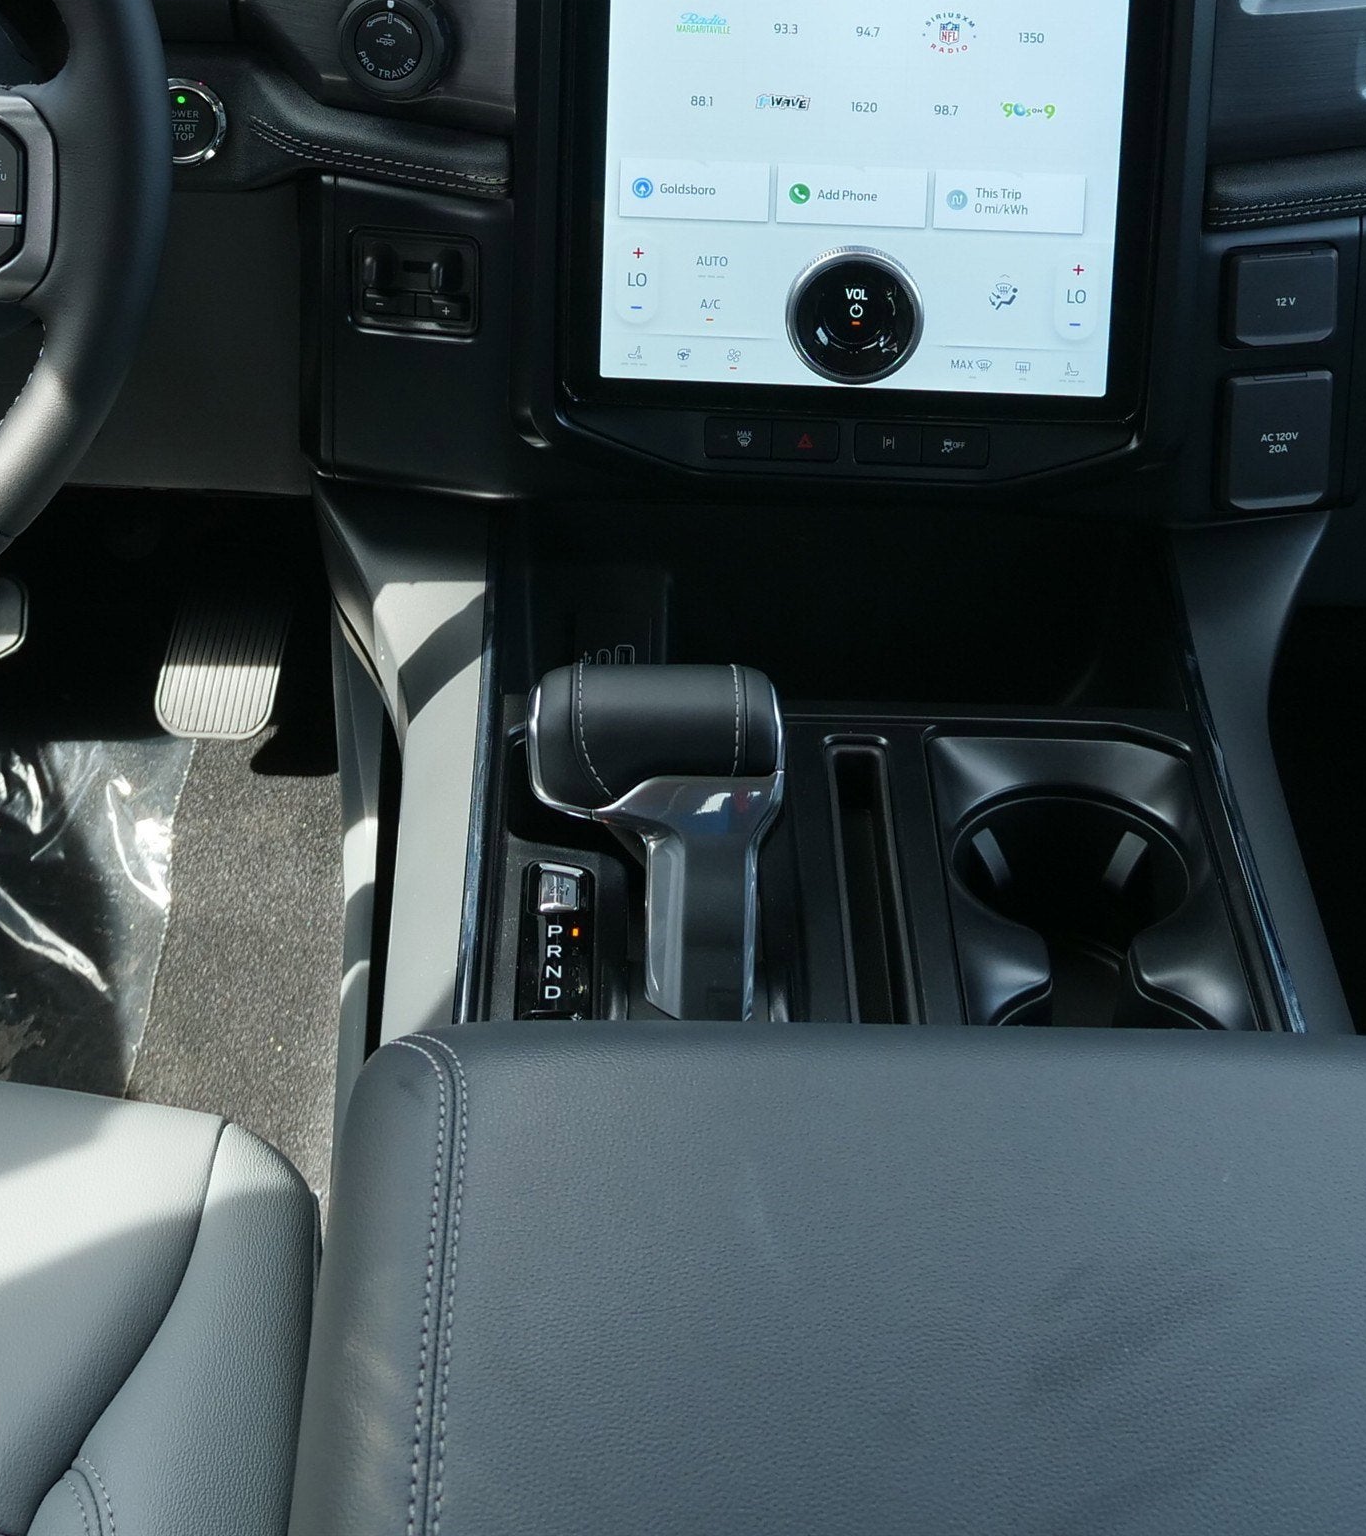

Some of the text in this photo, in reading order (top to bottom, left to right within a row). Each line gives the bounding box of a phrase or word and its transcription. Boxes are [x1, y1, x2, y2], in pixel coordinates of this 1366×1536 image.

[676, 24, 731, 35] MARGARITAVILLE
[773, 23, 799, 35] 93.3
[855, 26, 881, 38] 94.7
[941, 31, 958, 42] NFL
[1018, 32, 1045, 44] 1350
[930, 43, 969, 54] RADIO
[358, 50, 416, 79] PRO TRAILER
[690, 95, 714, 107] 88.1
[851, 102, 878, 113] 1620
[934, 105, 959, 116] 98.7
[172, 110, 199, 119] OWER
[172, 124, 197, 133] TART
[174, 132, 195, 141] TOP
[659, 183, 716, 196] Goldsboro
[817, 189, 878, 202] Add Phone
[976, 188, 1022, 201] This Trip
[974, 203, 1028, 215] 0 mi/kWh
[696, 255, 728, 267] AUTO
[627, 272, 647, 287] LO
[845, 288, 868, 301] VOL
[1067, 289, 1087, 304] LO
[700, 298, 721, 310] A/C
[1275, 297, 1296, 307] 12 V
[950, 359, 974, 370] MAX
[1260, 432, 1299, 442] AC 120V
[953, 441, 966, 449] OFF
[1268, 444, 1288, 454] 20A
[547, 924, 563, 938] P
[546, 945, 562, 958] R
[545, 965, 562, 978] N
[544, 986, 561, 999] D
